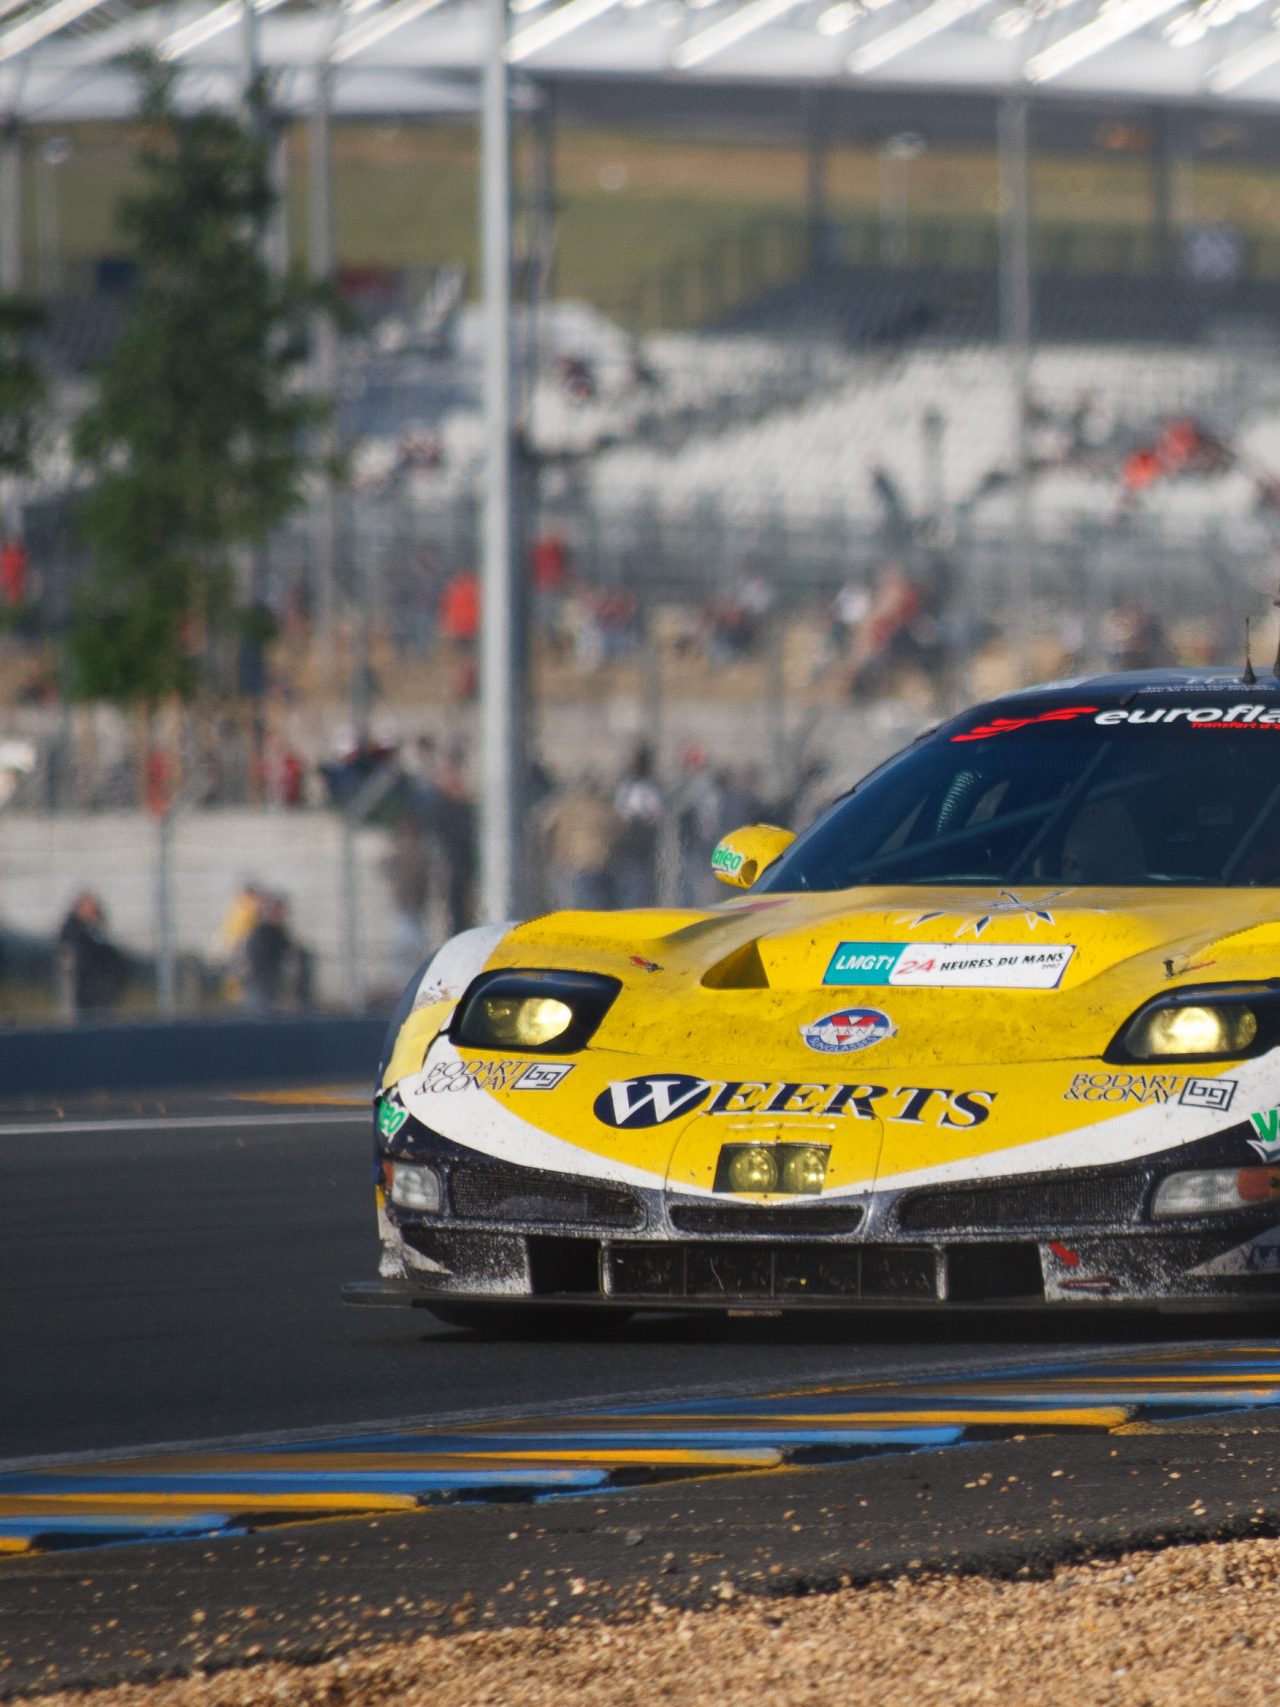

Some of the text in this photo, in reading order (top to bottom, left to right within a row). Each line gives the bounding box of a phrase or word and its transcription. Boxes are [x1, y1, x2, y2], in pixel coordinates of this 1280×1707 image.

[835, 953, 895, 971] LMGT1
[896, 951, 1066, 977] 24 HEURES DU MANS
[809, 1035, 877, 1053] SUNGLASSES
[428, 1061, 529, 1079] BODART
[1071, 1073, 1184, 1090] BODART
[606, 1080, 998, 1130] WEERTS
